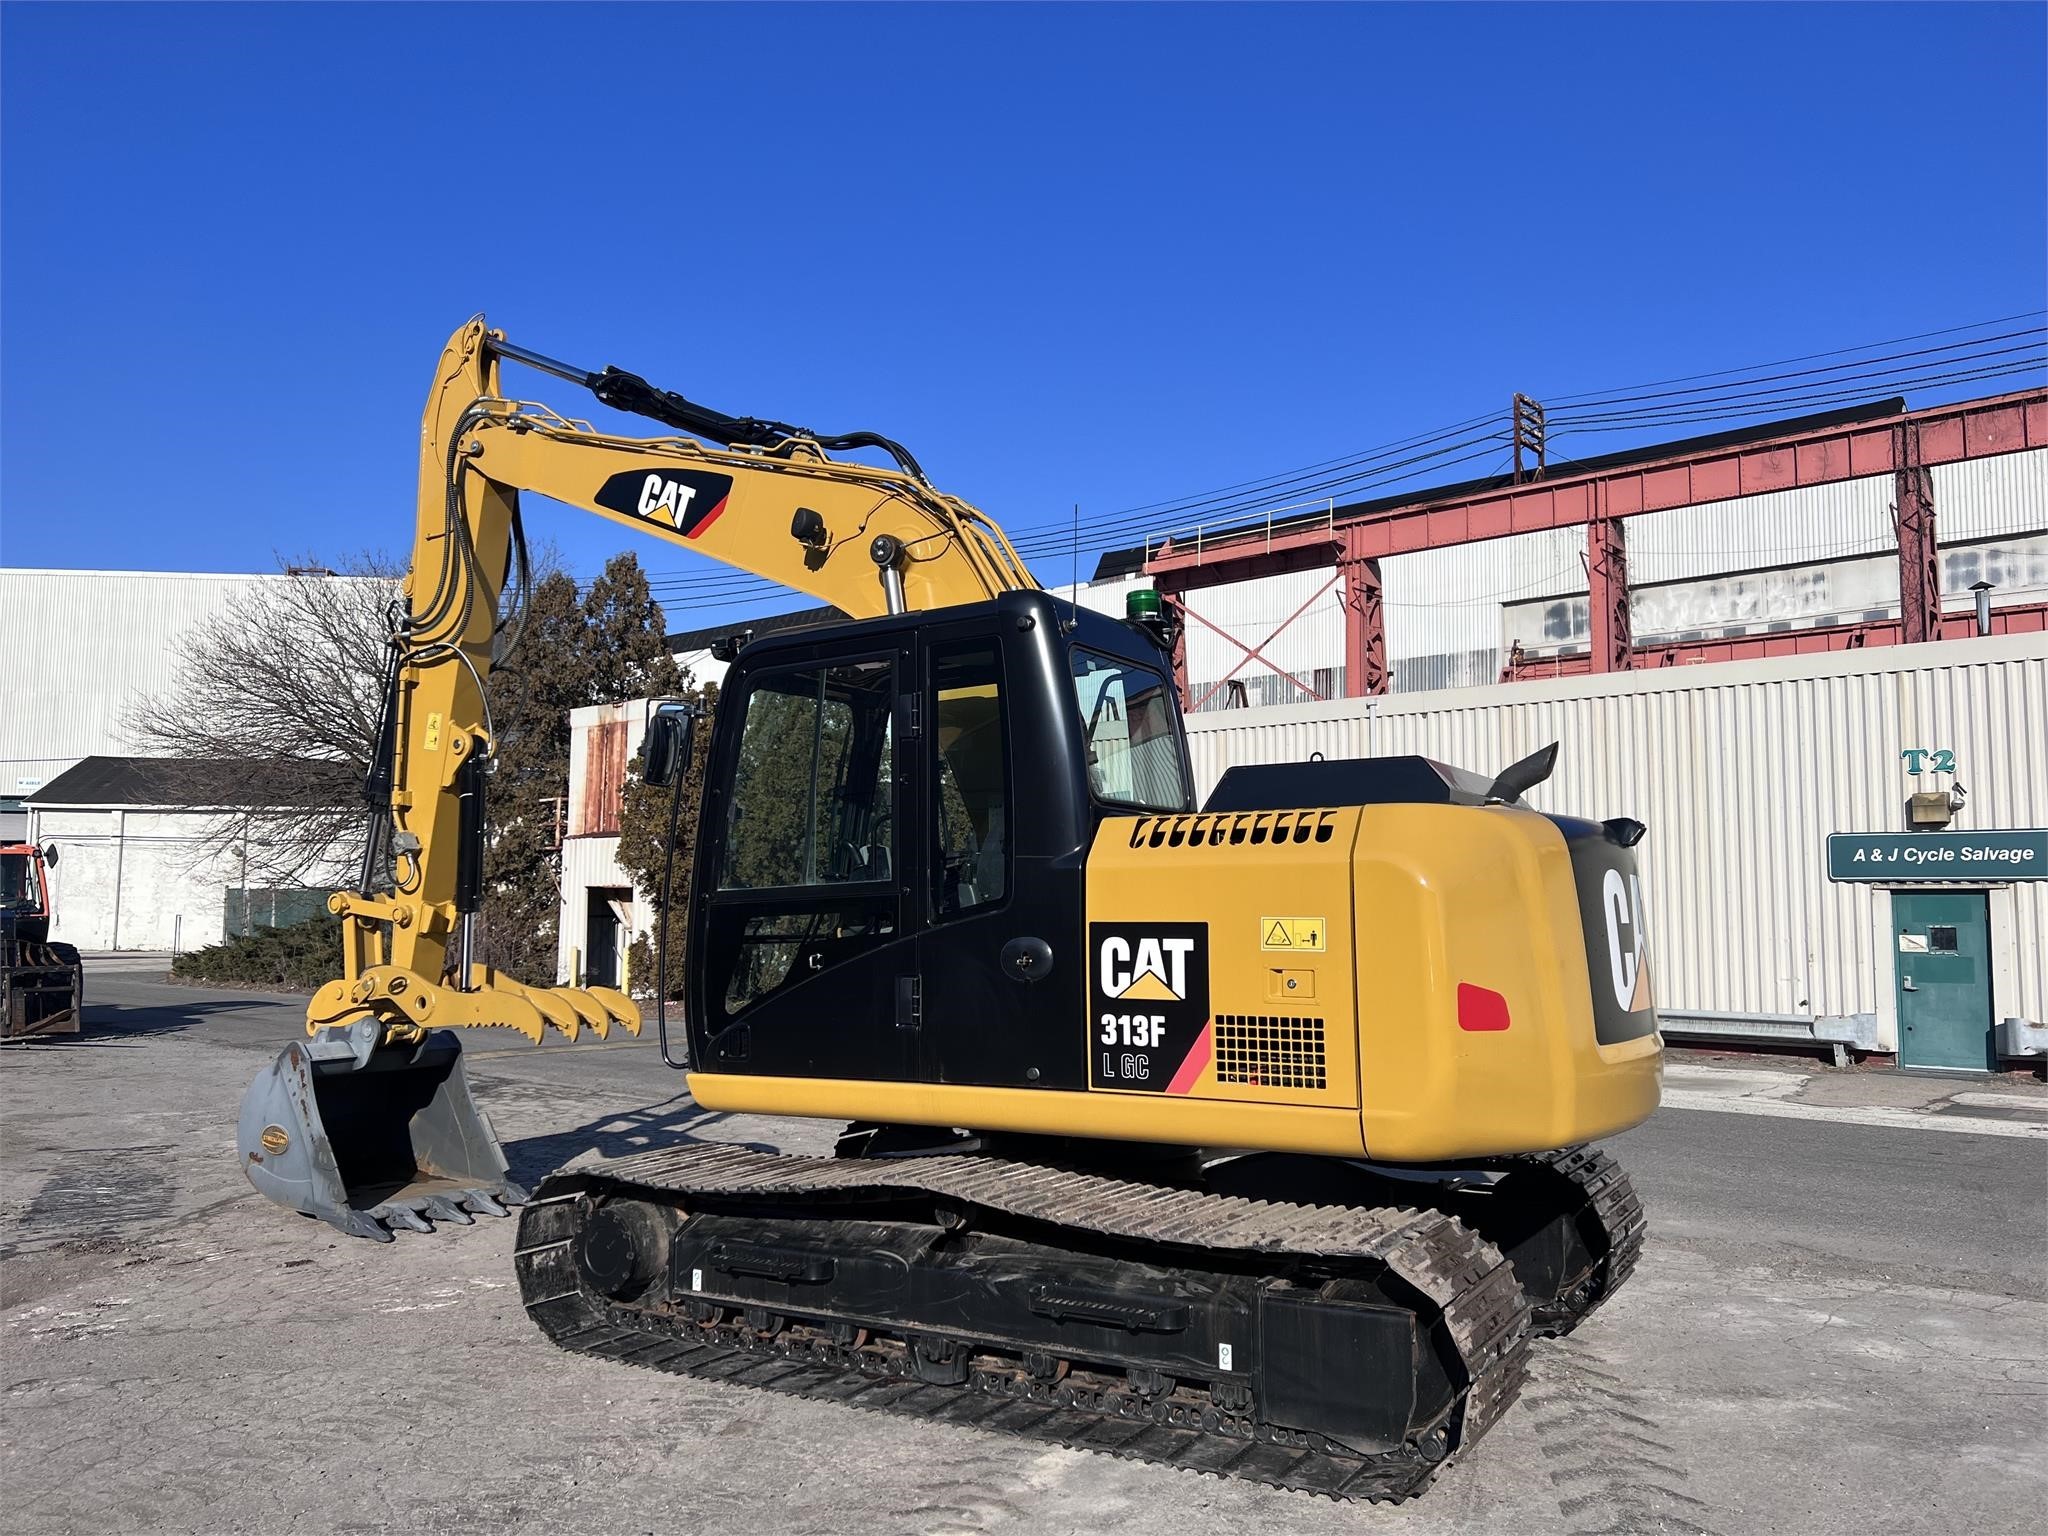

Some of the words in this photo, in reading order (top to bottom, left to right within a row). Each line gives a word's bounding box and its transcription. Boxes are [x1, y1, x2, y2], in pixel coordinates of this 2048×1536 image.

[637, 474, 697, 529] CAT
[1901, 748, 1957, 774] T2
[1852, 848, 1866, 862] A
[1870, 848, 1883, 862] &
[1887, 847, 1899, 862] J
[1903, 847, 1955, 865] Cycle
[1960, 846, 2035, 864] Salvage
[1603, 868, 1652, 1012] CA
[1100, 936, 1194, 1001] CAT
[1101, 1013, 1166, 1047] 313F
[1103, 1053, 1115, 1078] L
[1120, 1054, 1150, 1080] GC
